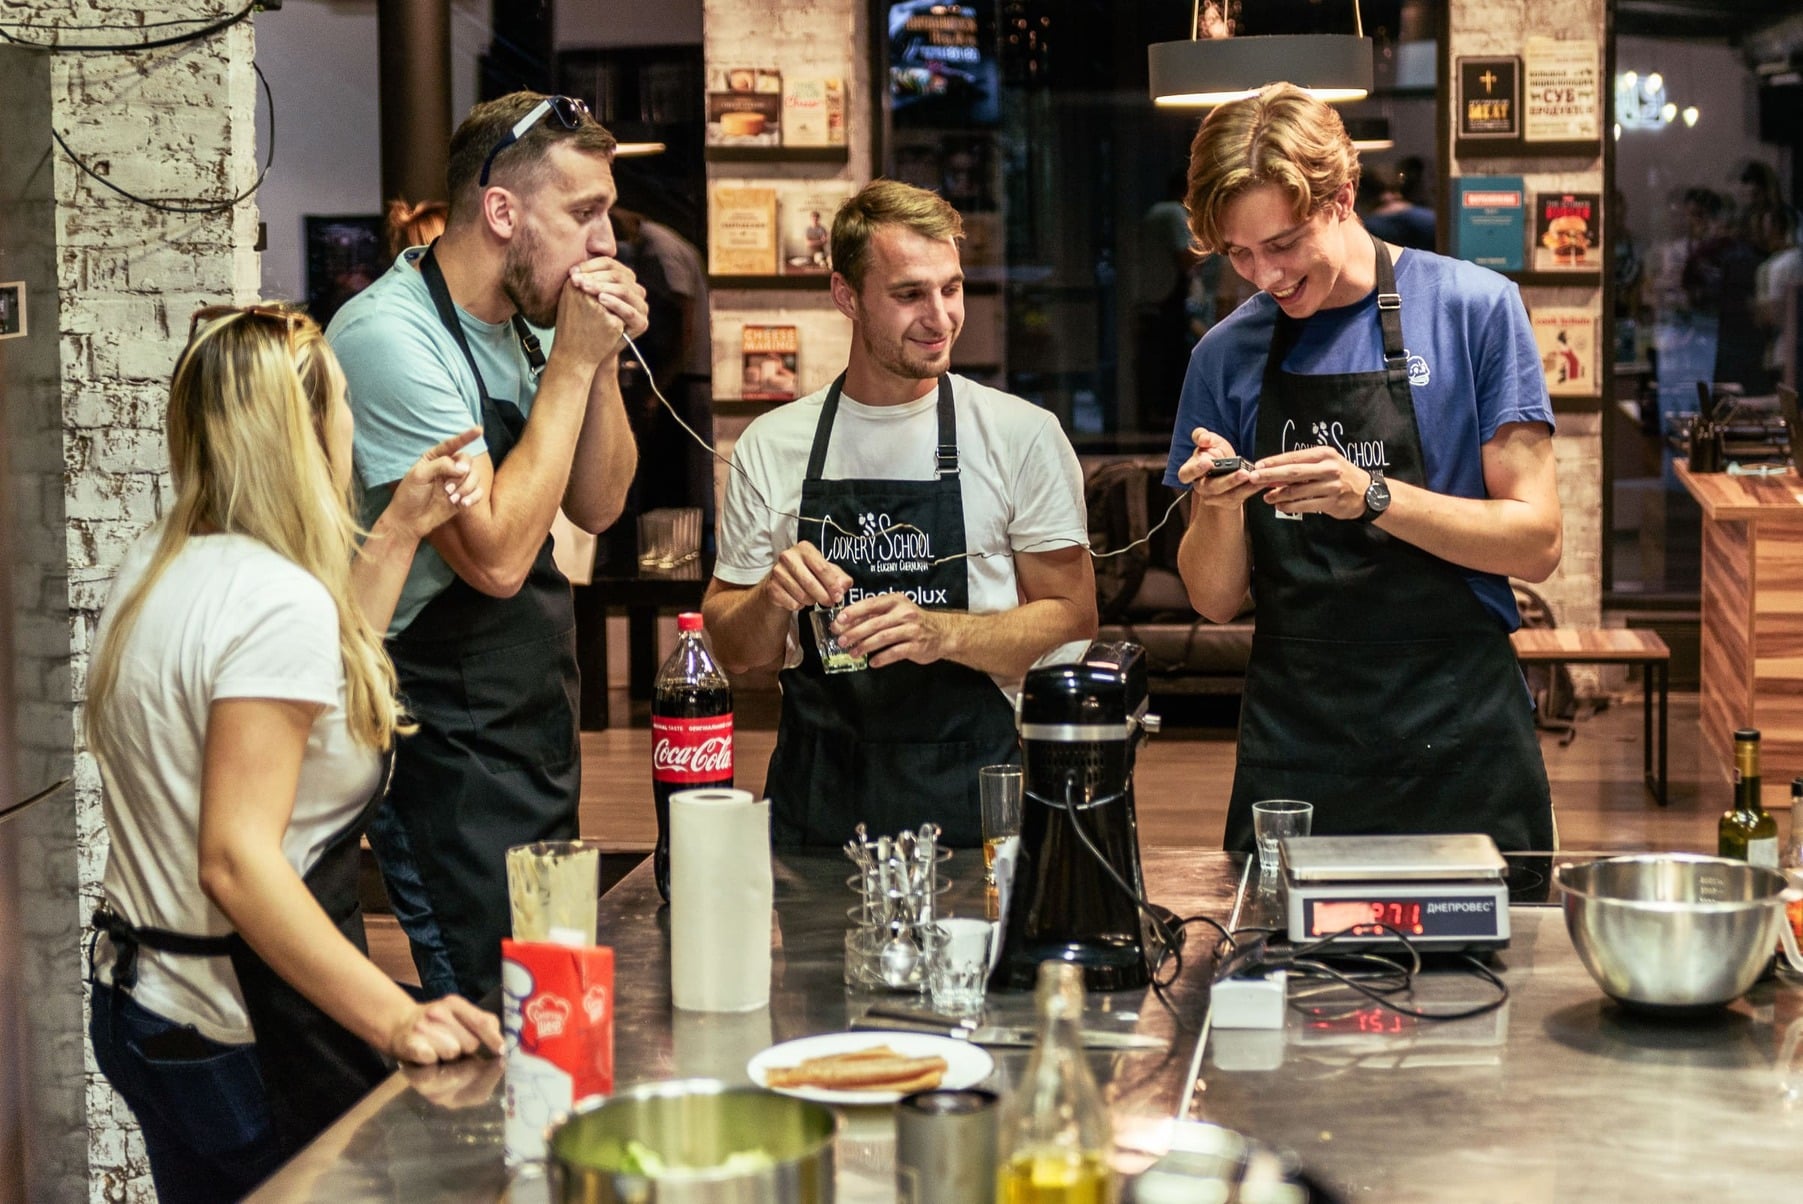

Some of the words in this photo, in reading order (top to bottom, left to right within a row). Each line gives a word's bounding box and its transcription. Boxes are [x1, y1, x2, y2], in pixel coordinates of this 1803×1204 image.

[1543, 88, 1575, 103] СУБ
[1331, 421, 1391, 467] SCHOOL
[821, 514, 876, 564] COOKERY
[879, 513, 935, 560] SCHOOL
[653, 735, 732, 773] Coca-Cola
[1427, 902, 1491, 914] ДНЕПРОВЕС
